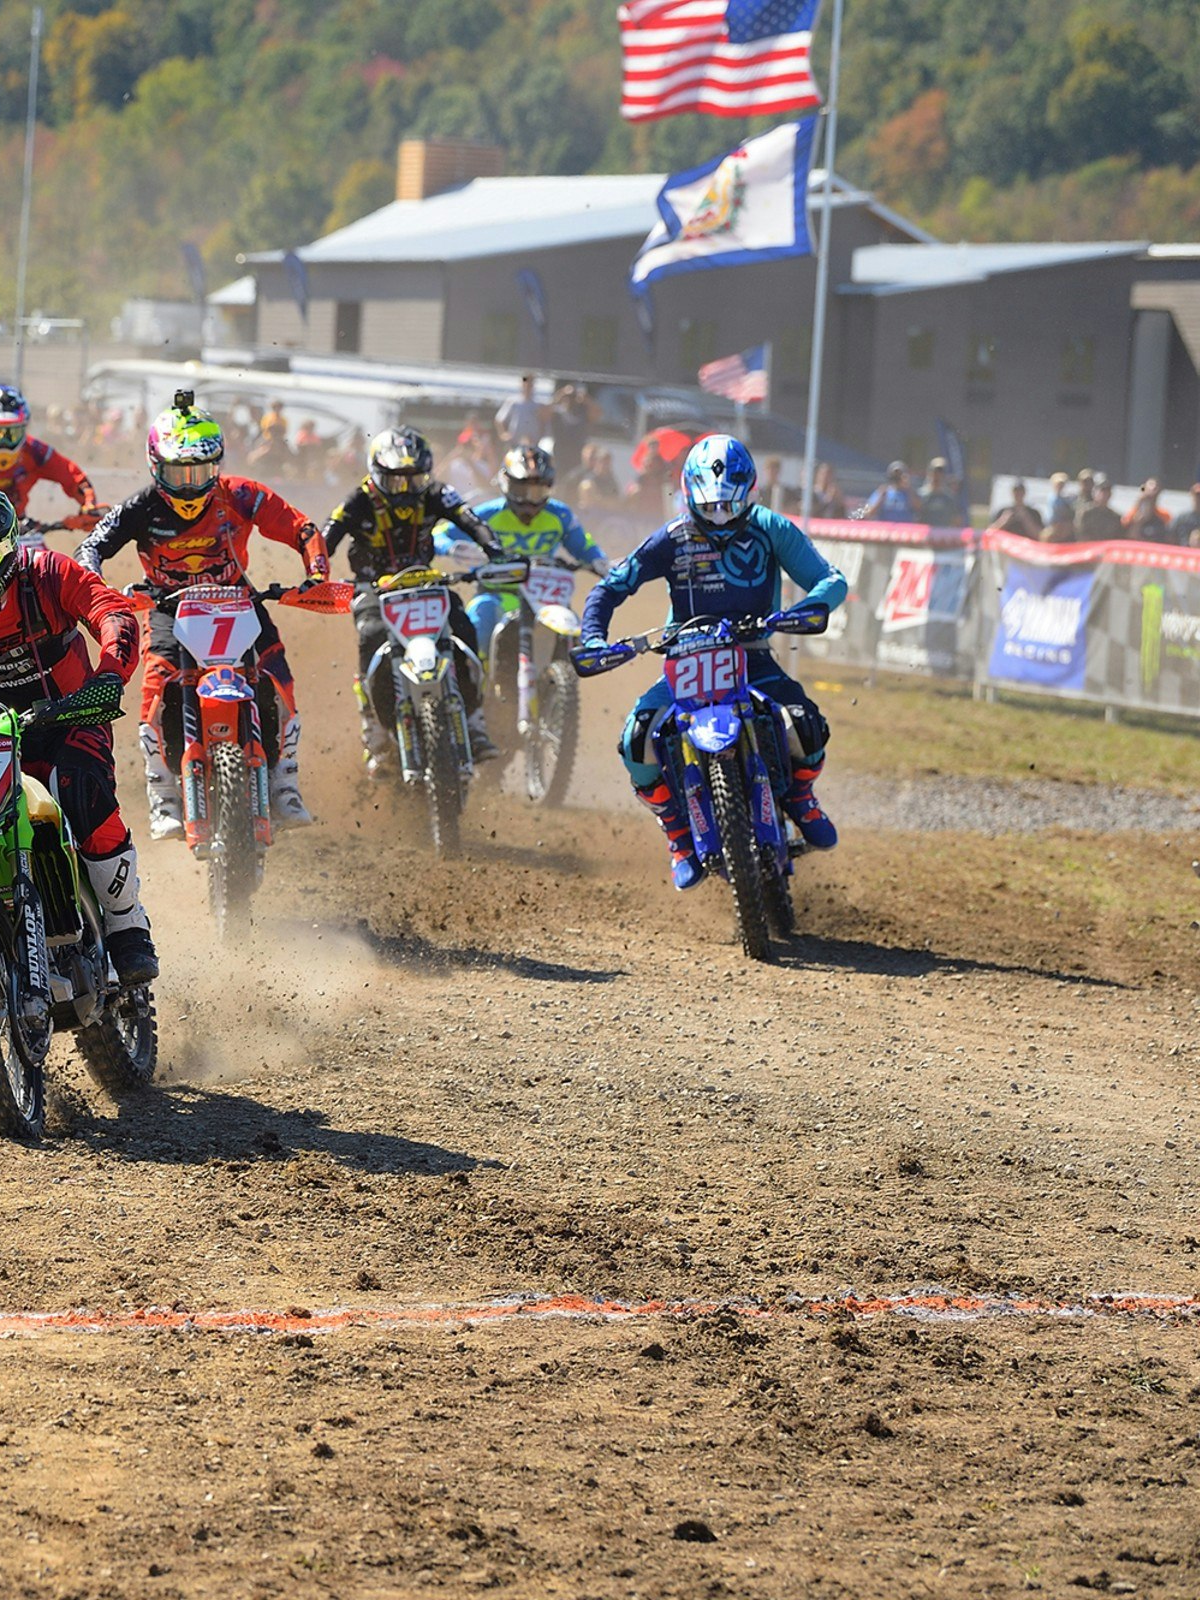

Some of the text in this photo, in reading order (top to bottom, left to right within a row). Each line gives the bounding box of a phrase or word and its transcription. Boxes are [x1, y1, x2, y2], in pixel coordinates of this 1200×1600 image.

[185, 591, 243, 600] RENTHAL
[527, 574, 572, 602] 523
[391, 599, 443, 630] 739
[208, 617, 236, 656] 1
[675, 650, 738, 699] 212
[762, 785, 773, 826] KENDA
[25, 904, 41, 989] DUNLOP
